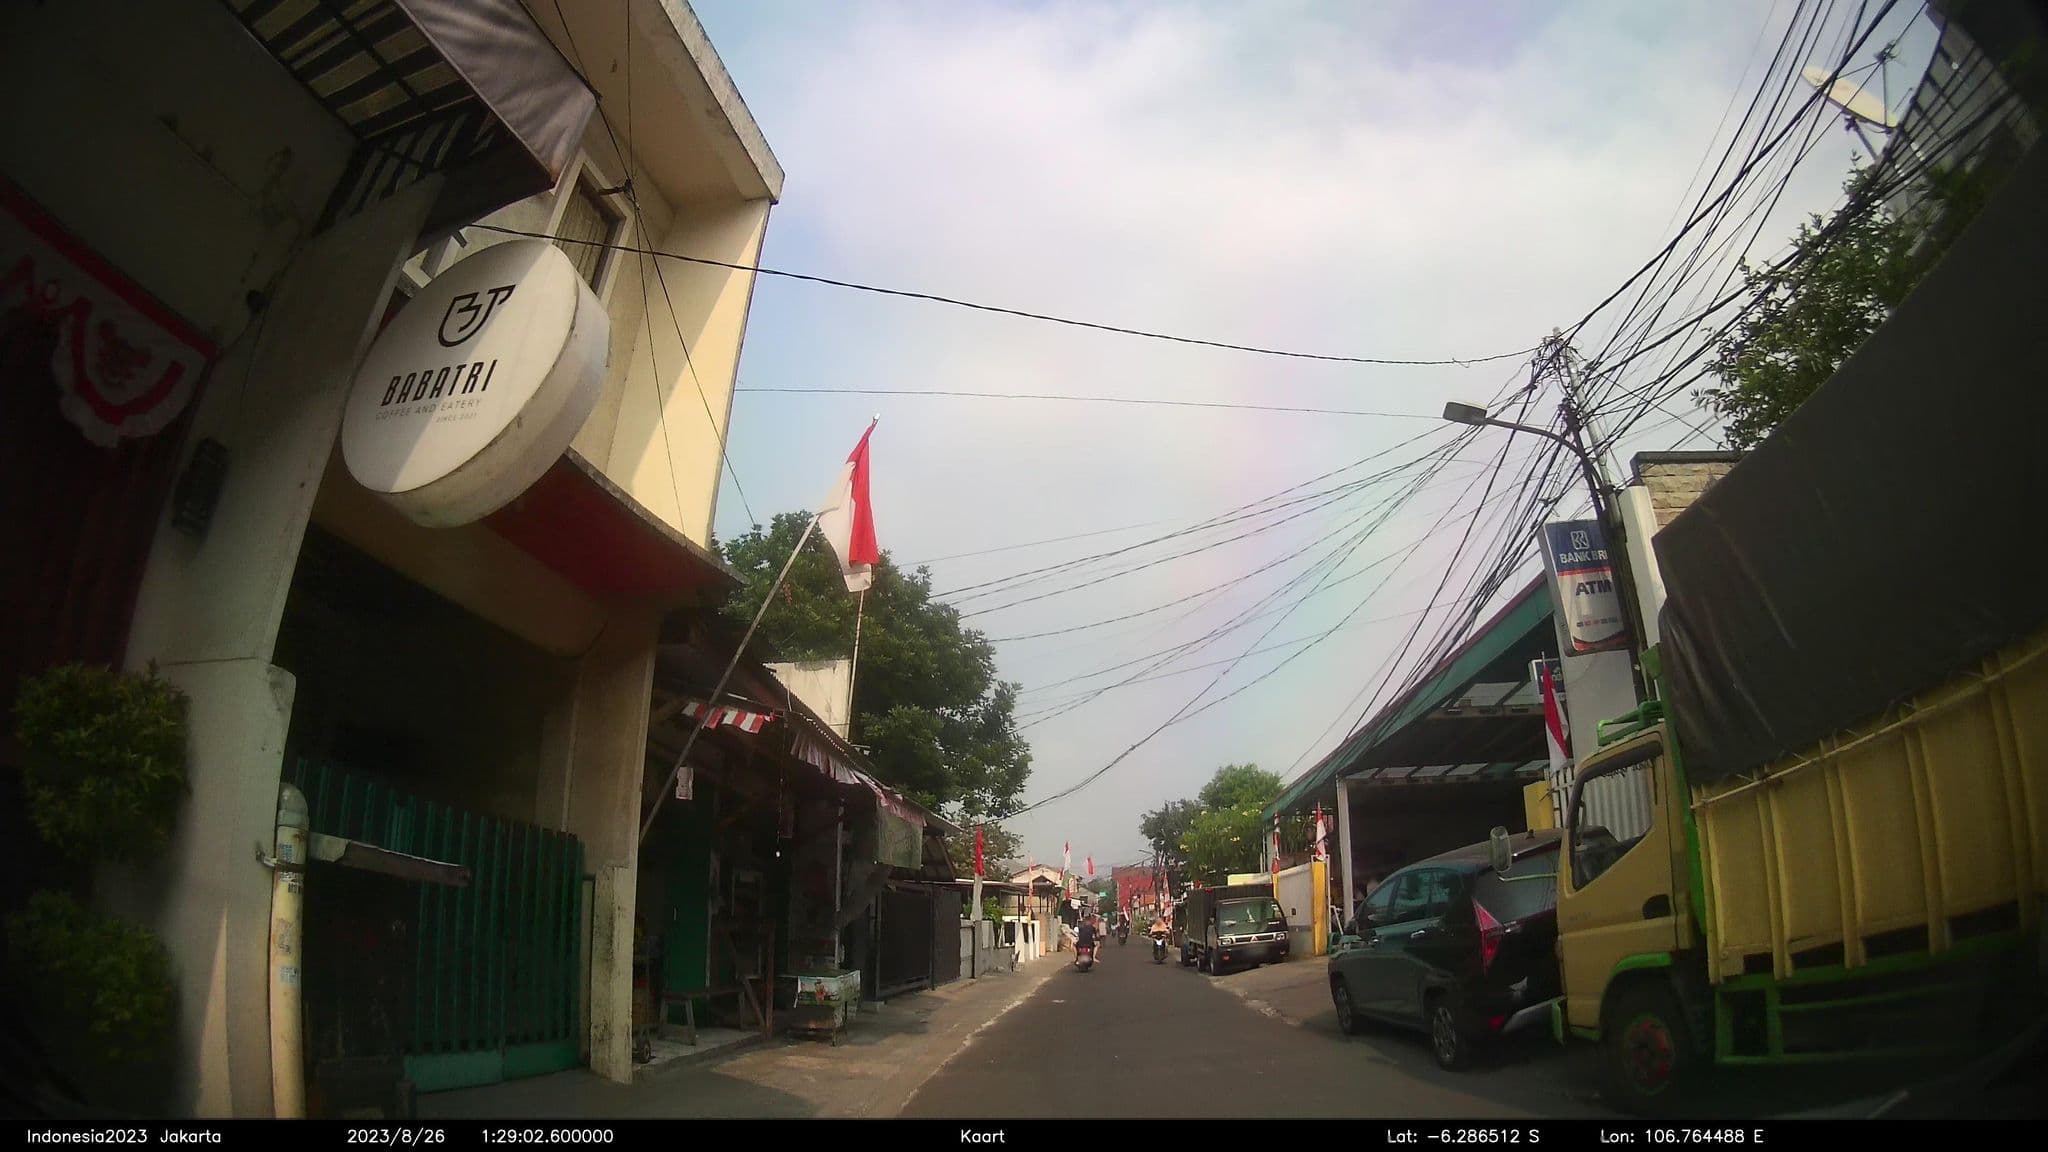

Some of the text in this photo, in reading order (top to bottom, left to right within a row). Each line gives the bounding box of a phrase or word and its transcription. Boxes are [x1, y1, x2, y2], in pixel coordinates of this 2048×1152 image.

[381, 359, 498, 406] BABATRI
[376, 399, 480, 421] COFFEE AND EATERY
[1560, 549, 1608, 564] BANK BRI
[1576, 579, 1612, 596] ATM
